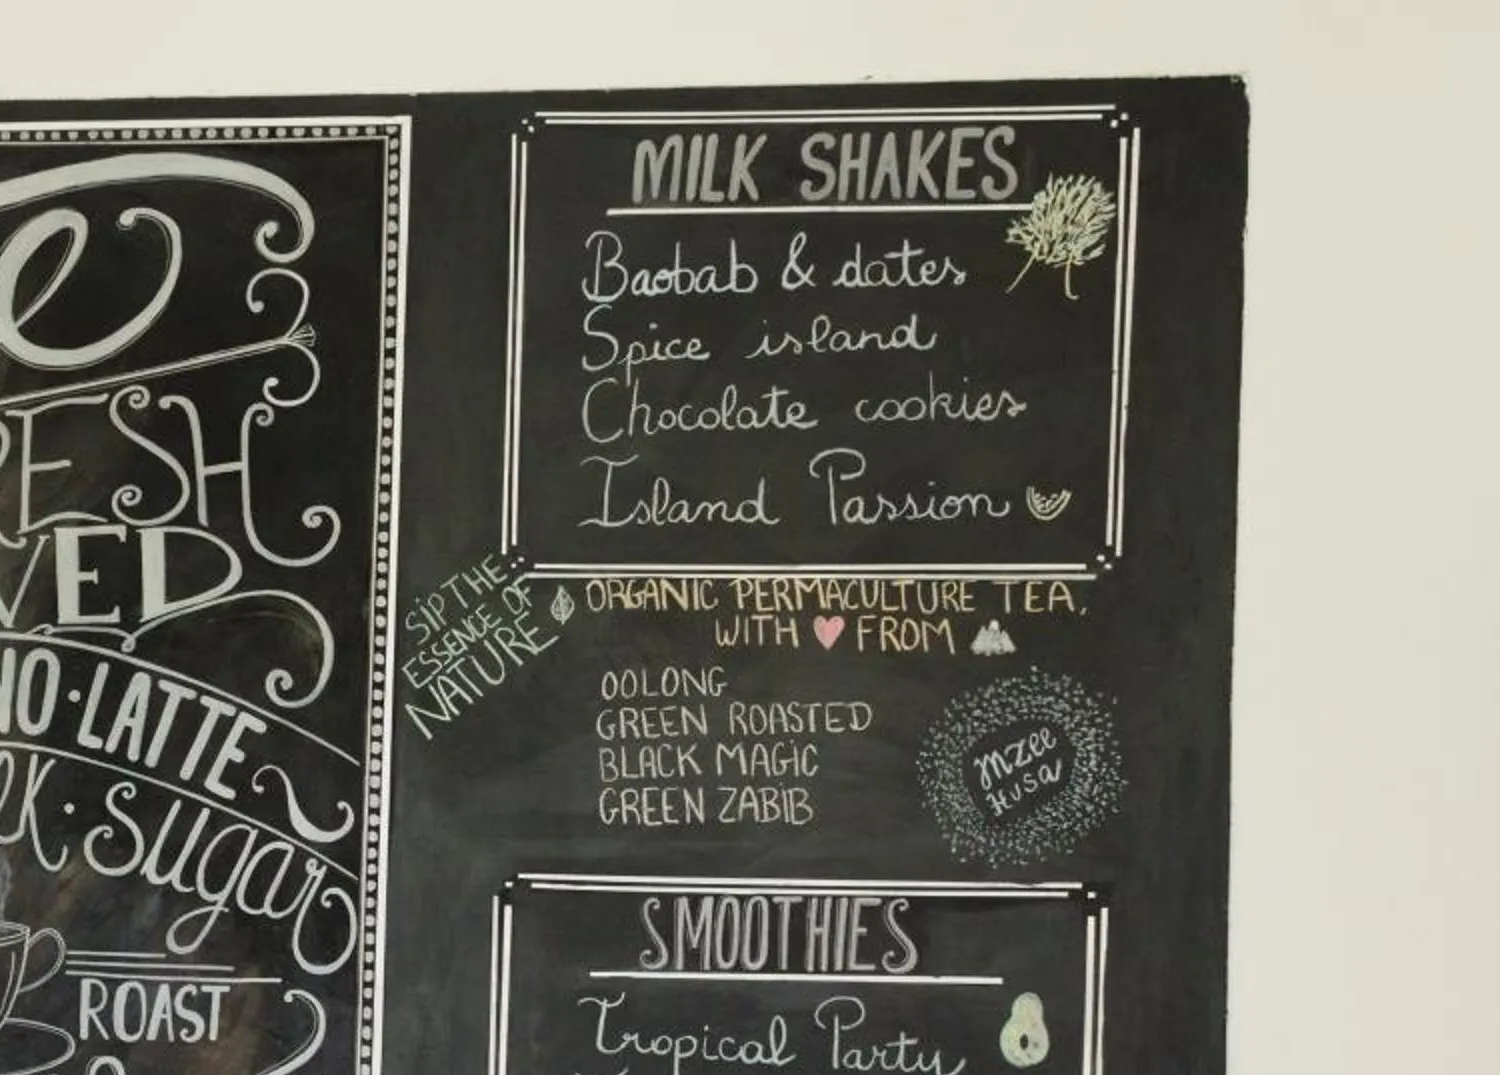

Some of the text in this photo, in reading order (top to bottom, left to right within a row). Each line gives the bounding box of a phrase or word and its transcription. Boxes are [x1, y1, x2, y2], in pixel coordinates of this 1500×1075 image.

[631, 126, 1018, 203] MILK SHAKES
[581, 230, 967, 301] Baobab & dates
[581, 302, 937, 386] Spice island
[581, 372, 1027, 443] Chocolate cookies
[578, 448, 1011, 527] Island Passion
[440, 554, 508, 609] THE
[585, 579, 719, 613] ORGANIC
[729, 579, 977, 615] PERMACULTURE
[402, 574, 532, 688] ESSENCE OF
[715, 616, 955, 654] WITH FROM
[404, 611, 559, 740] NATURE
[602, 666, 728, 700] OOLONG
[596, 702, 872, 739] GREEN ROASTED
[600, 744, 703, 782] BLACK
[600, 787, 704, 826] GREEN
[639, 896, 918, 973] SMOOTHIES
[80, 978, 230, 1042] ROAST
